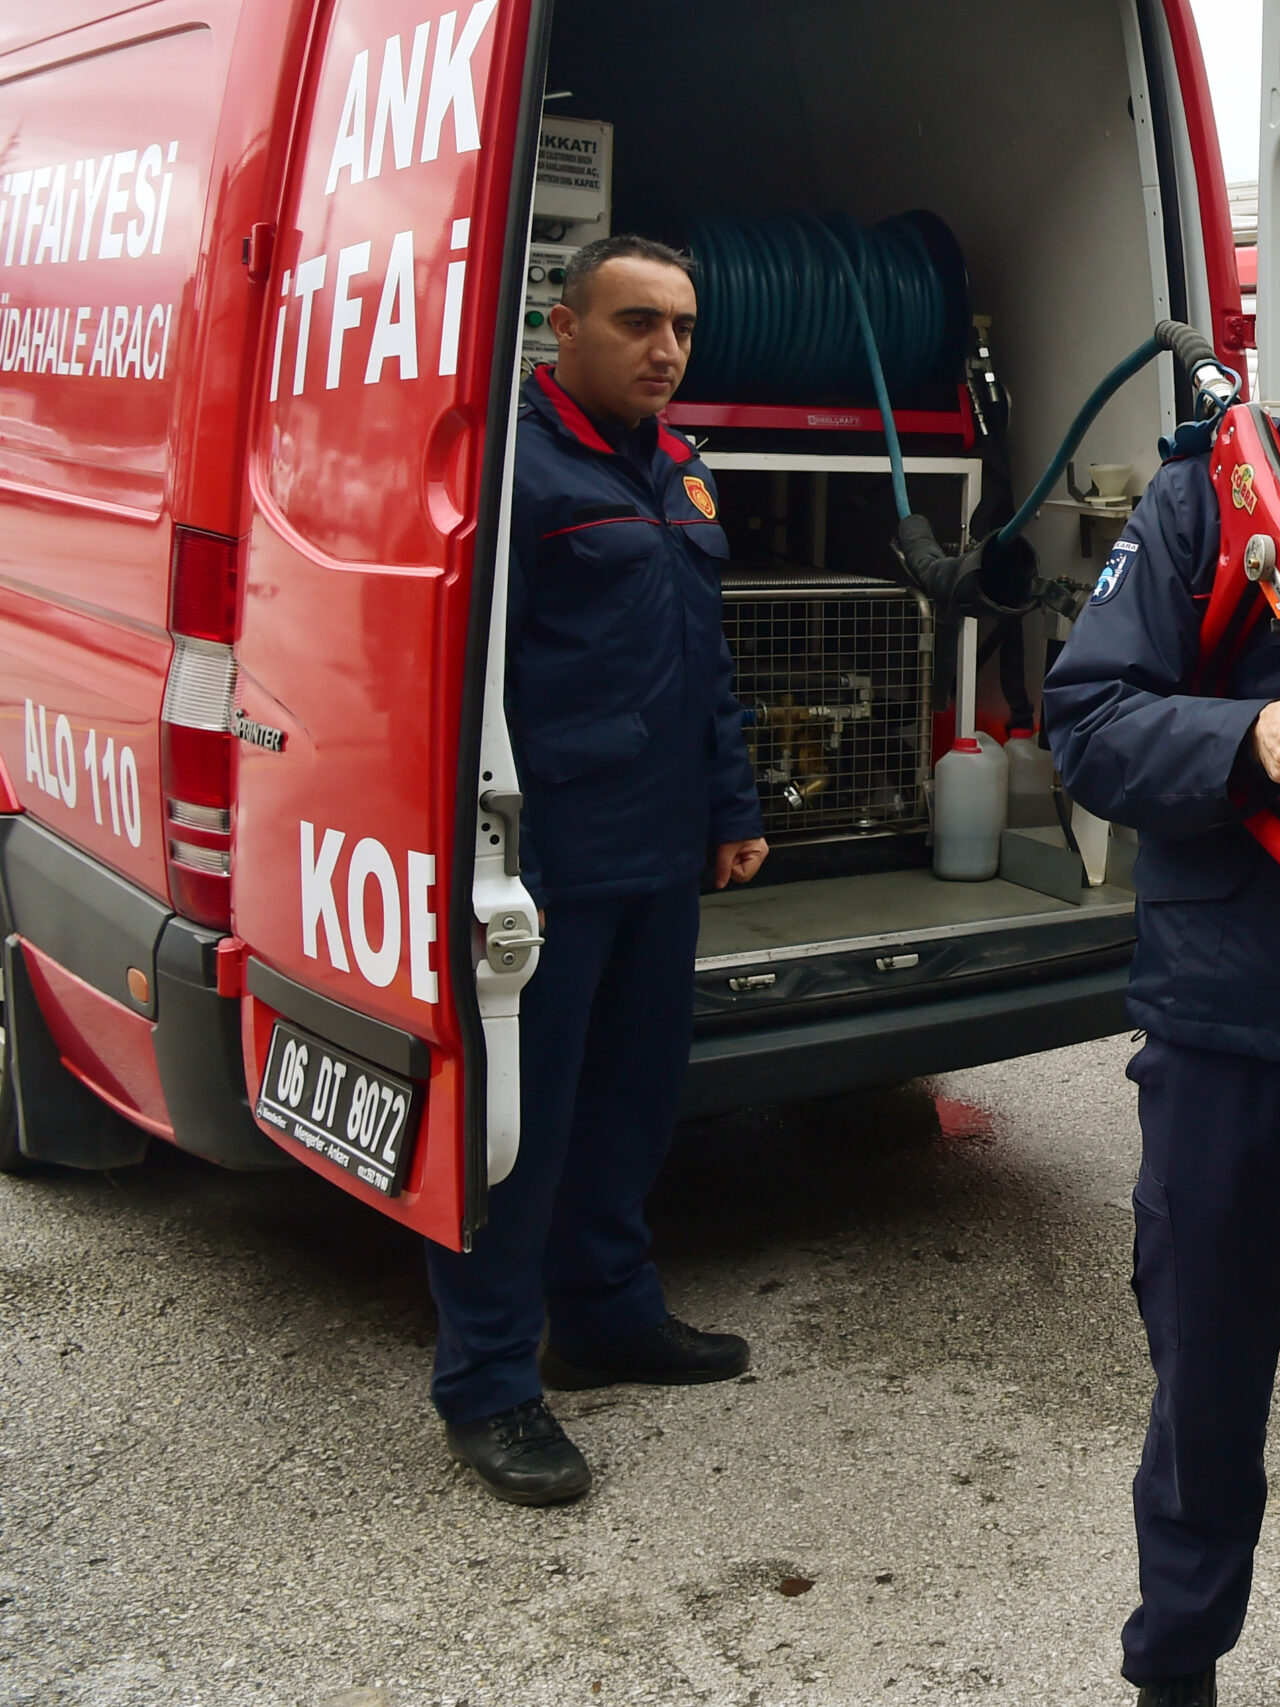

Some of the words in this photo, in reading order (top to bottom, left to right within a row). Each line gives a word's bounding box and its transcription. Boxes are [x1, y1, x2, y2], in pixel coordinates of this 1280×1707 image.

[325, 0, 497, 195] ANK
[88, 303, 172, 380] ARACI
[25, 698, 77, 809] ALO
[84, 728, 141, 848] 110
[277, 1039, 308, 1108] 06
[311, 1056, 347, 1128] DT
[347, 1075, 406, 1164] 8072
